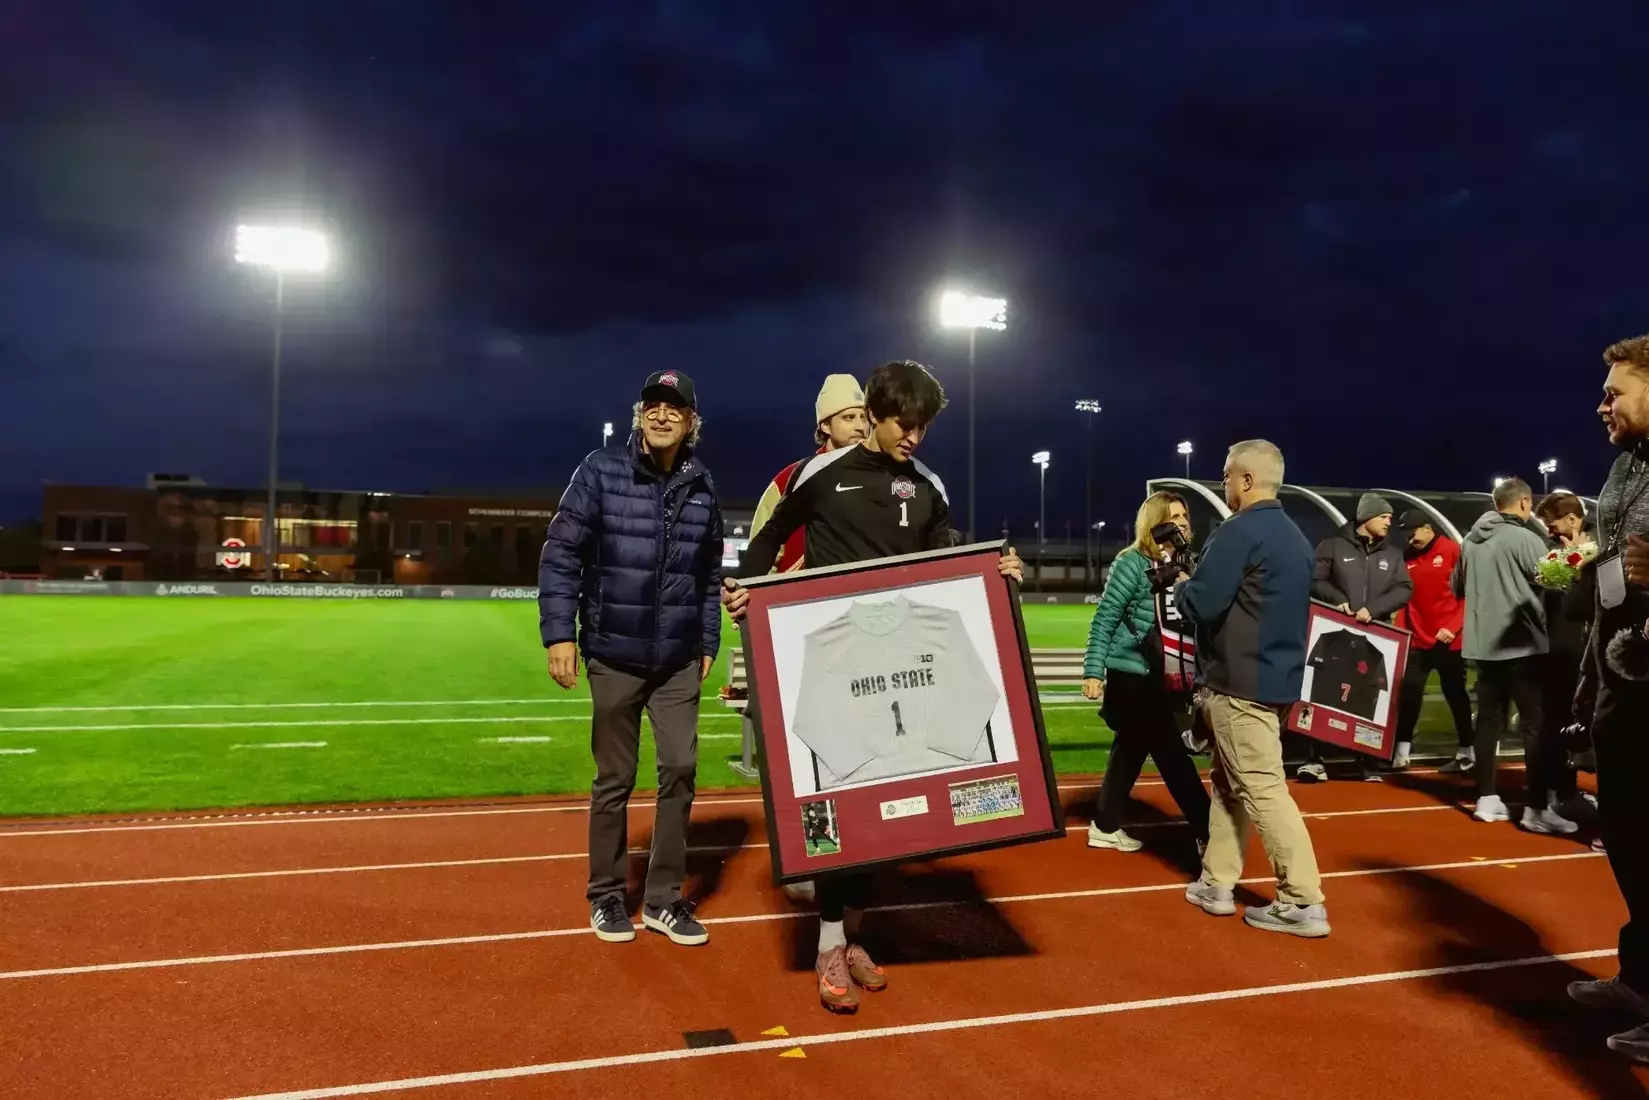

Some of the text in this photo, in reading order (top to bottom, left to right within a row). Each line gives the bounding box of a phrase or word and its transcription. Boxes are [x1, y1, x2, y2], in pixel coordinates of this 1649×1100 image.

[899, 501, 909, 527] 1
[169, 583, 217, 595] ANDURIL
[250, 585, 404, 599] OhioStateBuckeyes.com
[850, 667, 935, 698] OHIO STATE
[1340, 682, 1352, 702] 7
[891, 700, 906, 737] 1
